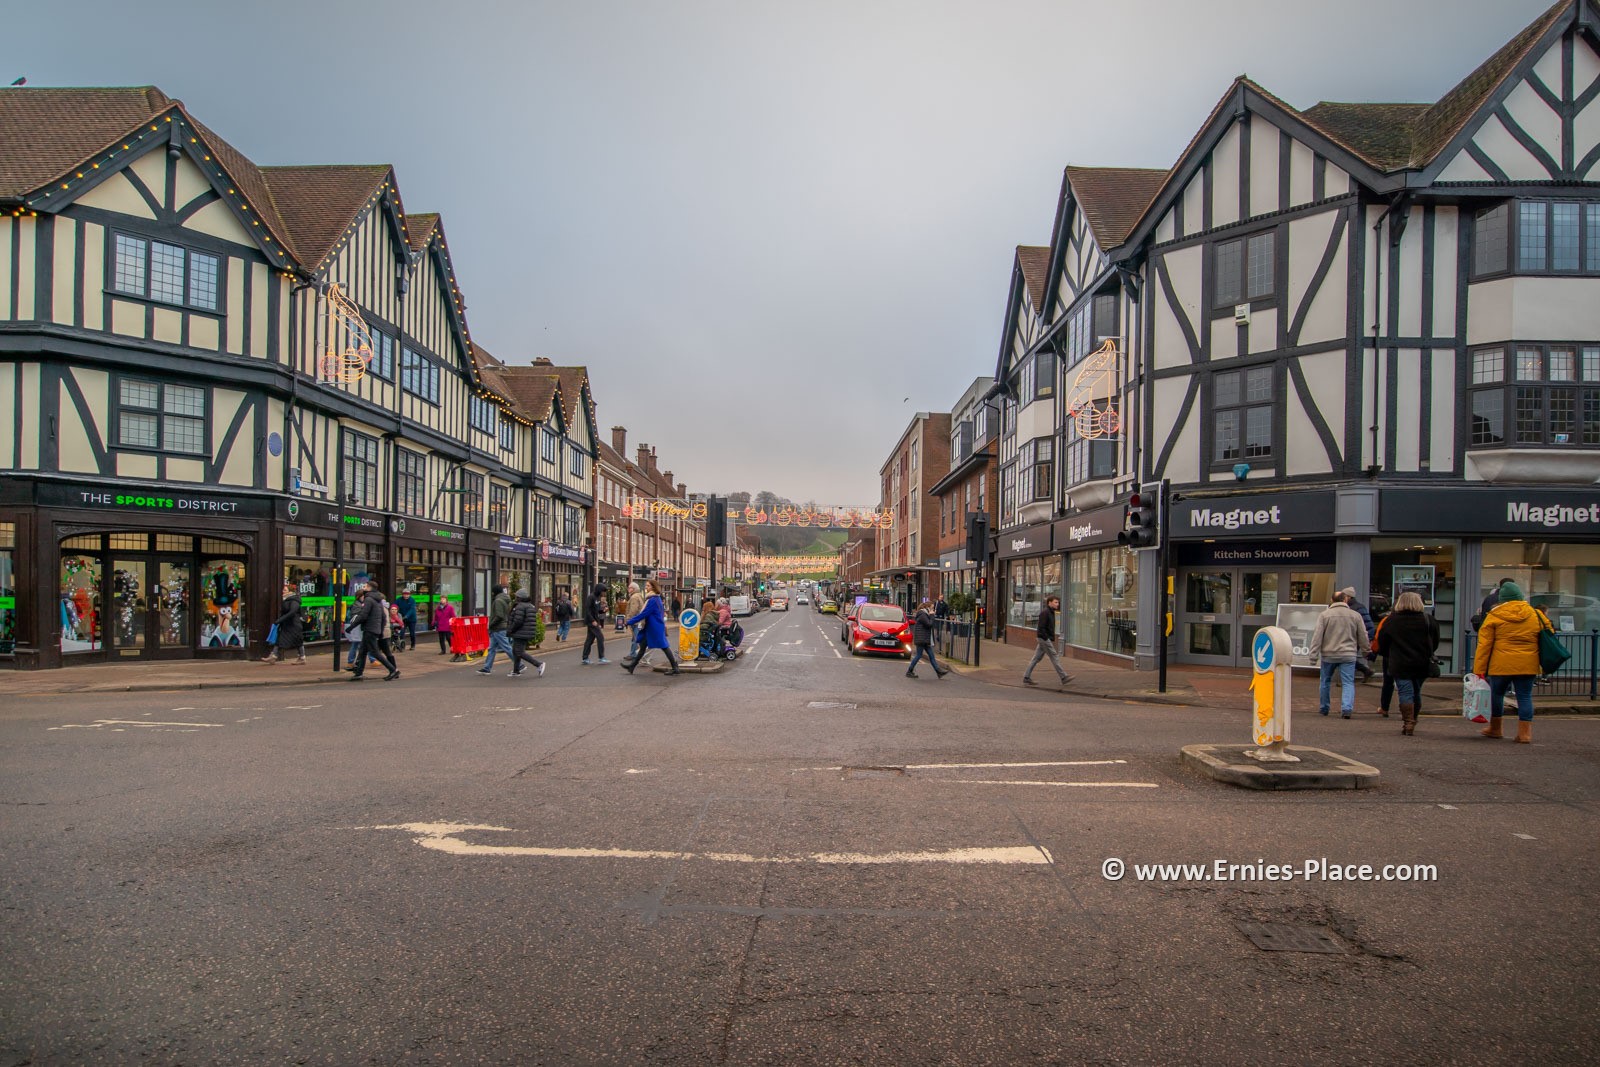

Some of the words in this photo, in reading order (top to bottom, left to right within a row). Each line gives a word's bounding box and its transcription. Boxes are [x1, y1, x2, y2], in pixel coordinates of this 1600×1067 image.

[80, 492, 112, 504] THE
[115, 495, 174, 508] SPORTS
[178, 499, 238, 512] DISTRICT
[328, 513, 339, 523] THE
[343, 515, 361, 525] PORTS
[361, 519, 382, 528] DISTRICT
[1190, 505, 1280, 530] Magnet
[1507, 502, 1600, 527] Magnet
[429, 528, 438, 536] THE
[1070, 522, 1091, 542] Magnet
[1214, 550, 1252, 559] Kitchen
[1254, 550, 1310, 558] Showroom
